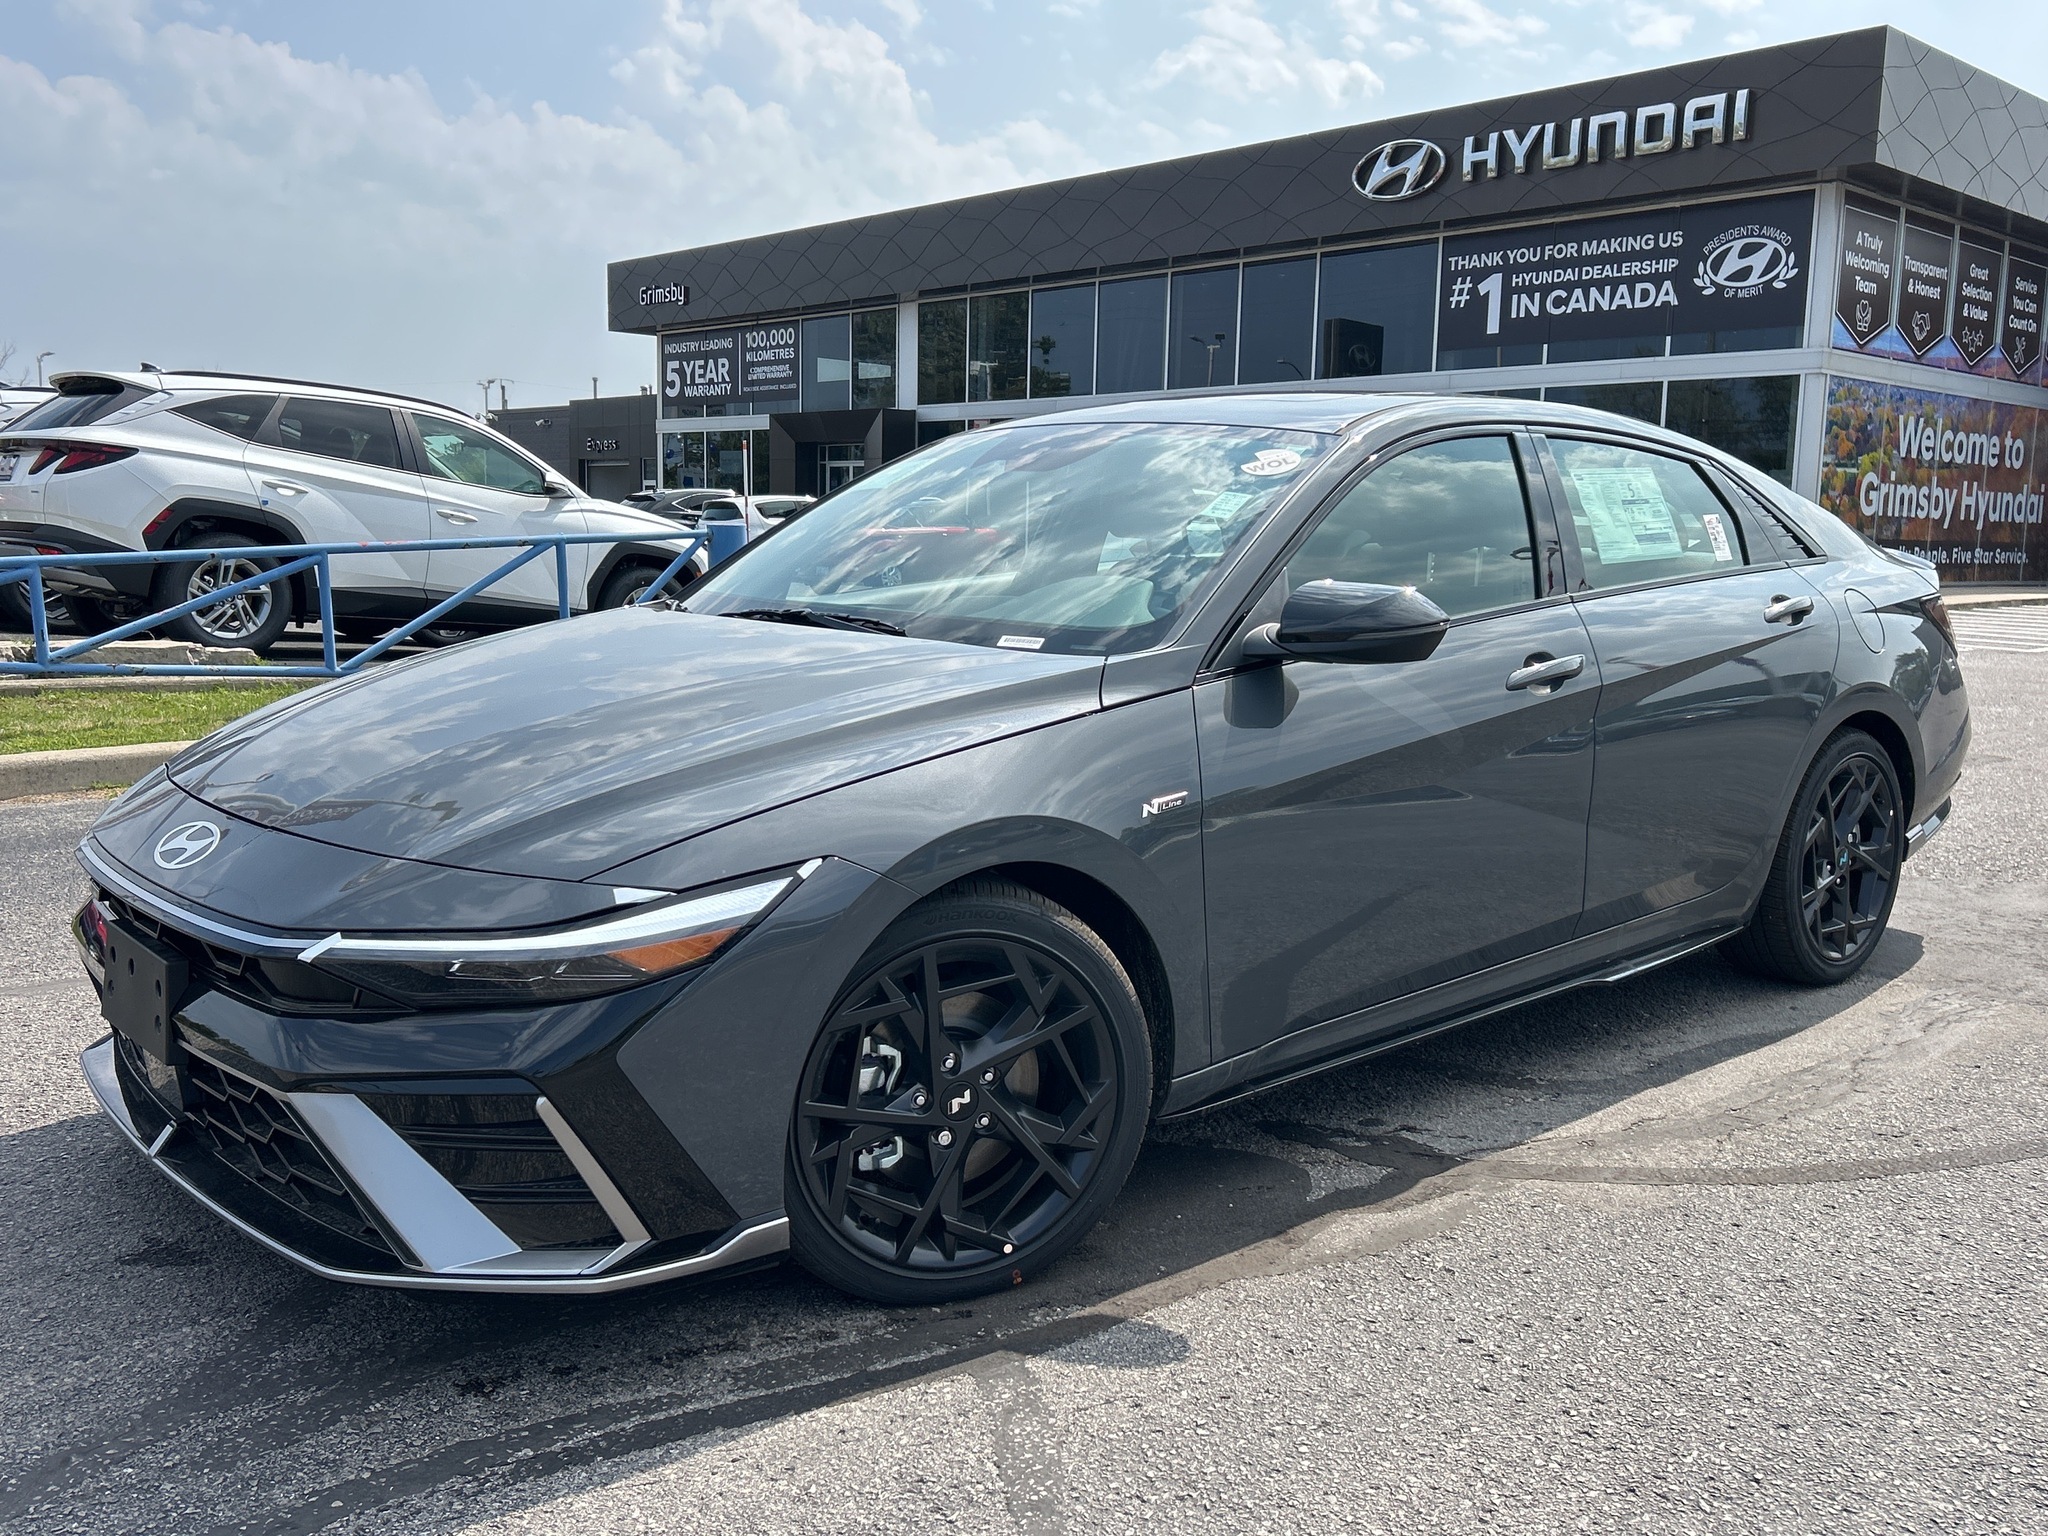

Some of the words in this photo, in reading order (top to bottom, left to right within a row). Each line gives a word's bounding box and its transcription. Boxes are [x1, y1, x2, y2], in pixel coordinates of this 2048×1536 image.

[1462, 88, 1750, 182] HYUNDAI
[1703, 225, 1759, 255] PRESIDENT'S
[1760, 225, 1792, 246] AWARD
[1855, 231, 1863, 246] A
[1864, 232, 1883, 254] Truly
[1448, 251, 1504, 271] THANK
[1507, 247, 1541, 264] YOU
[1544, 242, 1578, 260] FOR
[1582, 234, 1654, 256] MAKING
[1659, 231, 1684, 248] US
[1512, 267, 1579, 287] HYUNDAI
[1582, 258, 1679, 280] DEALERSHIP
[1845, 250, 1890, 279] Welcoming
[1904, 255, 1948, 280] Transparent
[1969, 263, 1989, 280] Great
[639, 281, 685, 305] Grimsby
[1724, 288, 1736, 298] OF
[1737, 284, 1763, 298] MERIT
[1855, 276, 1877, 295] Team
[1907, 278, 1914, 293] &
[1914, 280, 1940, 300] Honest
[1961, 281, 1993, 302] Selection
[2015, 276, 2038, 294] Service
[1511, 292, 1541, 318] IN
[1545, 280, 1678, 315] CANADA
[2012, 295, 2024, 310] You
[2024, 299, 2037, 314] Can
[1962, 303, 1969, 317] &
[1969, 304, 1988, 321] Value
[2008, 314, 2027, 331] Count
[2028, 319, 2037, 333] On
[664, 341, 700, 354] INDUSTRY
[700, 338, 733, 350] LEADING
[745, 328, 795, 349] 100,000
[746, 348, 795, 362] KILOMETRES
[665, 361, 680, 397] 5
[682, 358, 730, 384] YEAR
[684, 383, 732, 397] WARRANTY
[587, 437, 617, 453] Express
[1899, 414, 2000, 468] Welcome
[2004, 430, 2025, 470] to
[1859, 471, 1958, 529] Grimsby
[1959, 480, 2045, 531] Hyundai
[1952, 546, 1971, 564] Five
[1974, 547, 1994, 564] Star
[1994, 547, 2029, 564] Service.
[1162, 799, 1182, 810] Line
